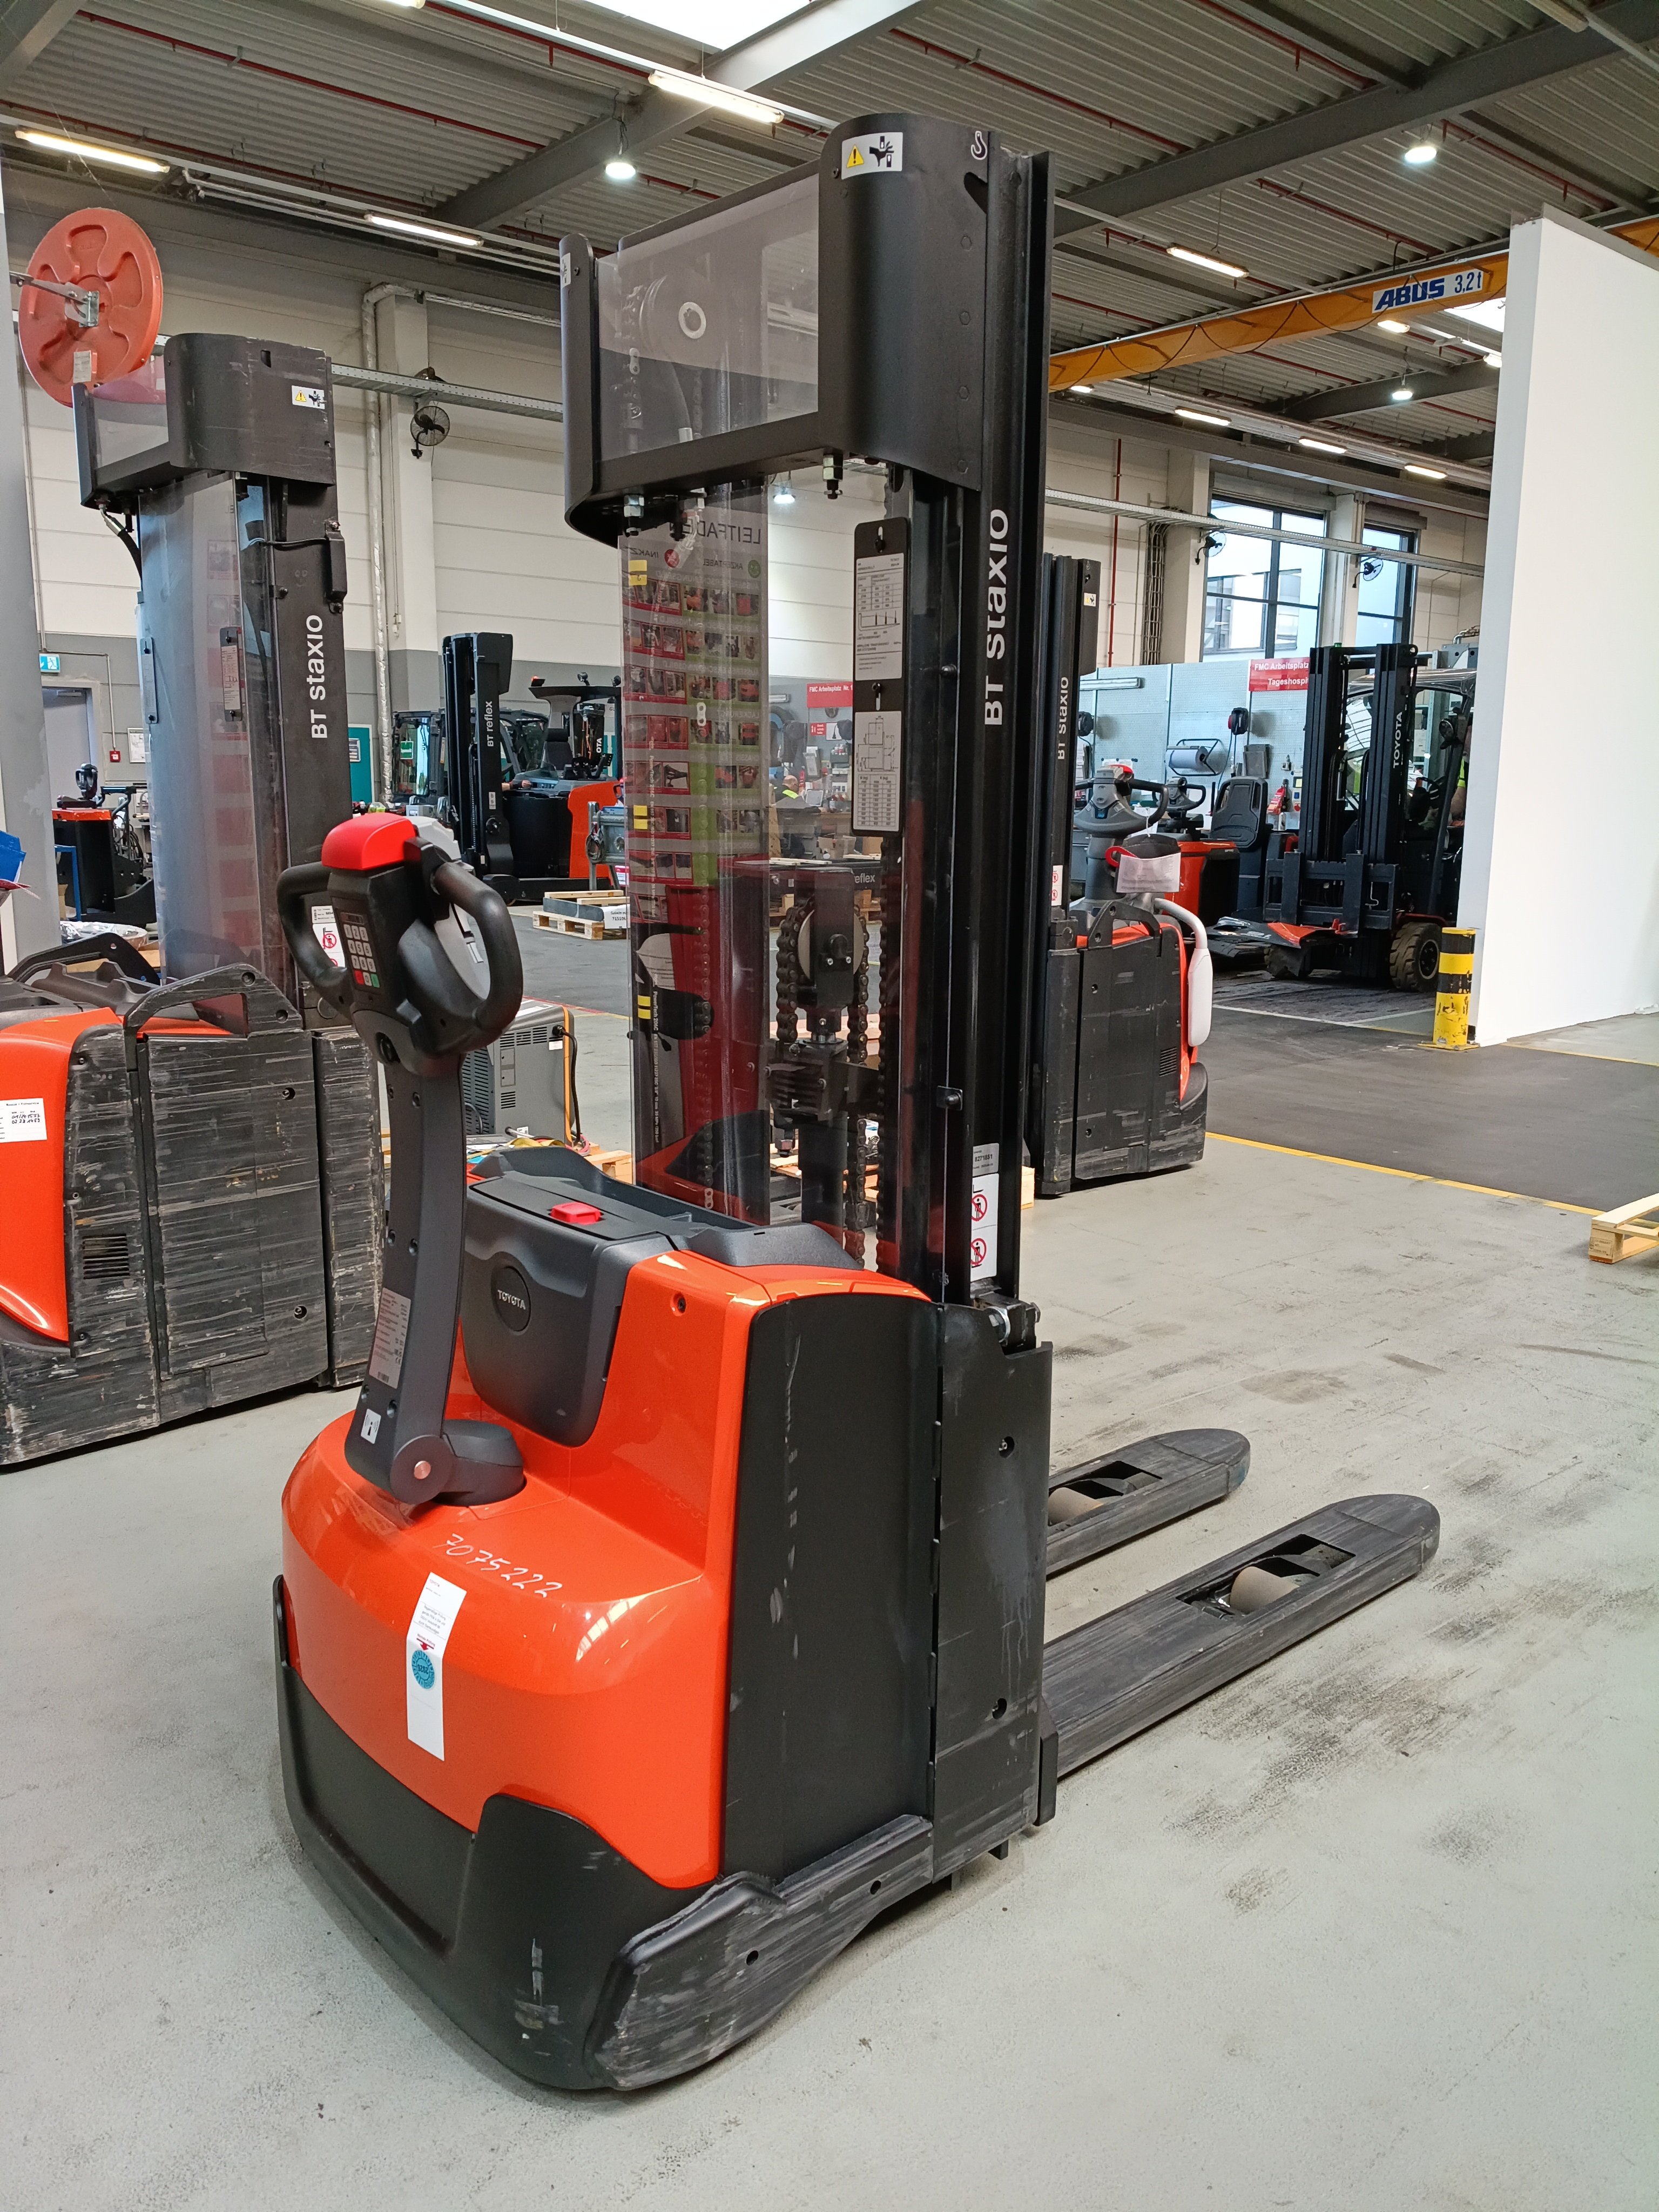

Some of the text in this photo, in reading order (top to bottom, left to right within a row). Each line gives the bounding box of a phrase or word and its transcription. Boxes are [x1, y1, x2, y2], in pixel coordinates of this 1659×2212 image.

[1374, 278, 1445, 311] ABUS
[1454, 272, 1475, 293] 3,2
[1270, 662, 1309, 671] Arbeitsplatz
[984, 675, 1003, 725] BT
[311, 709, 328, 738] BT
[487, 734, 494, 747] BT
[1393, 711, 1402, 768] TOYOTA
[854, 873, 875, 884] eflex
[497, 1290, 526, 1310] TOYOTA
[433, 1533, 563, 1598] 7075222
